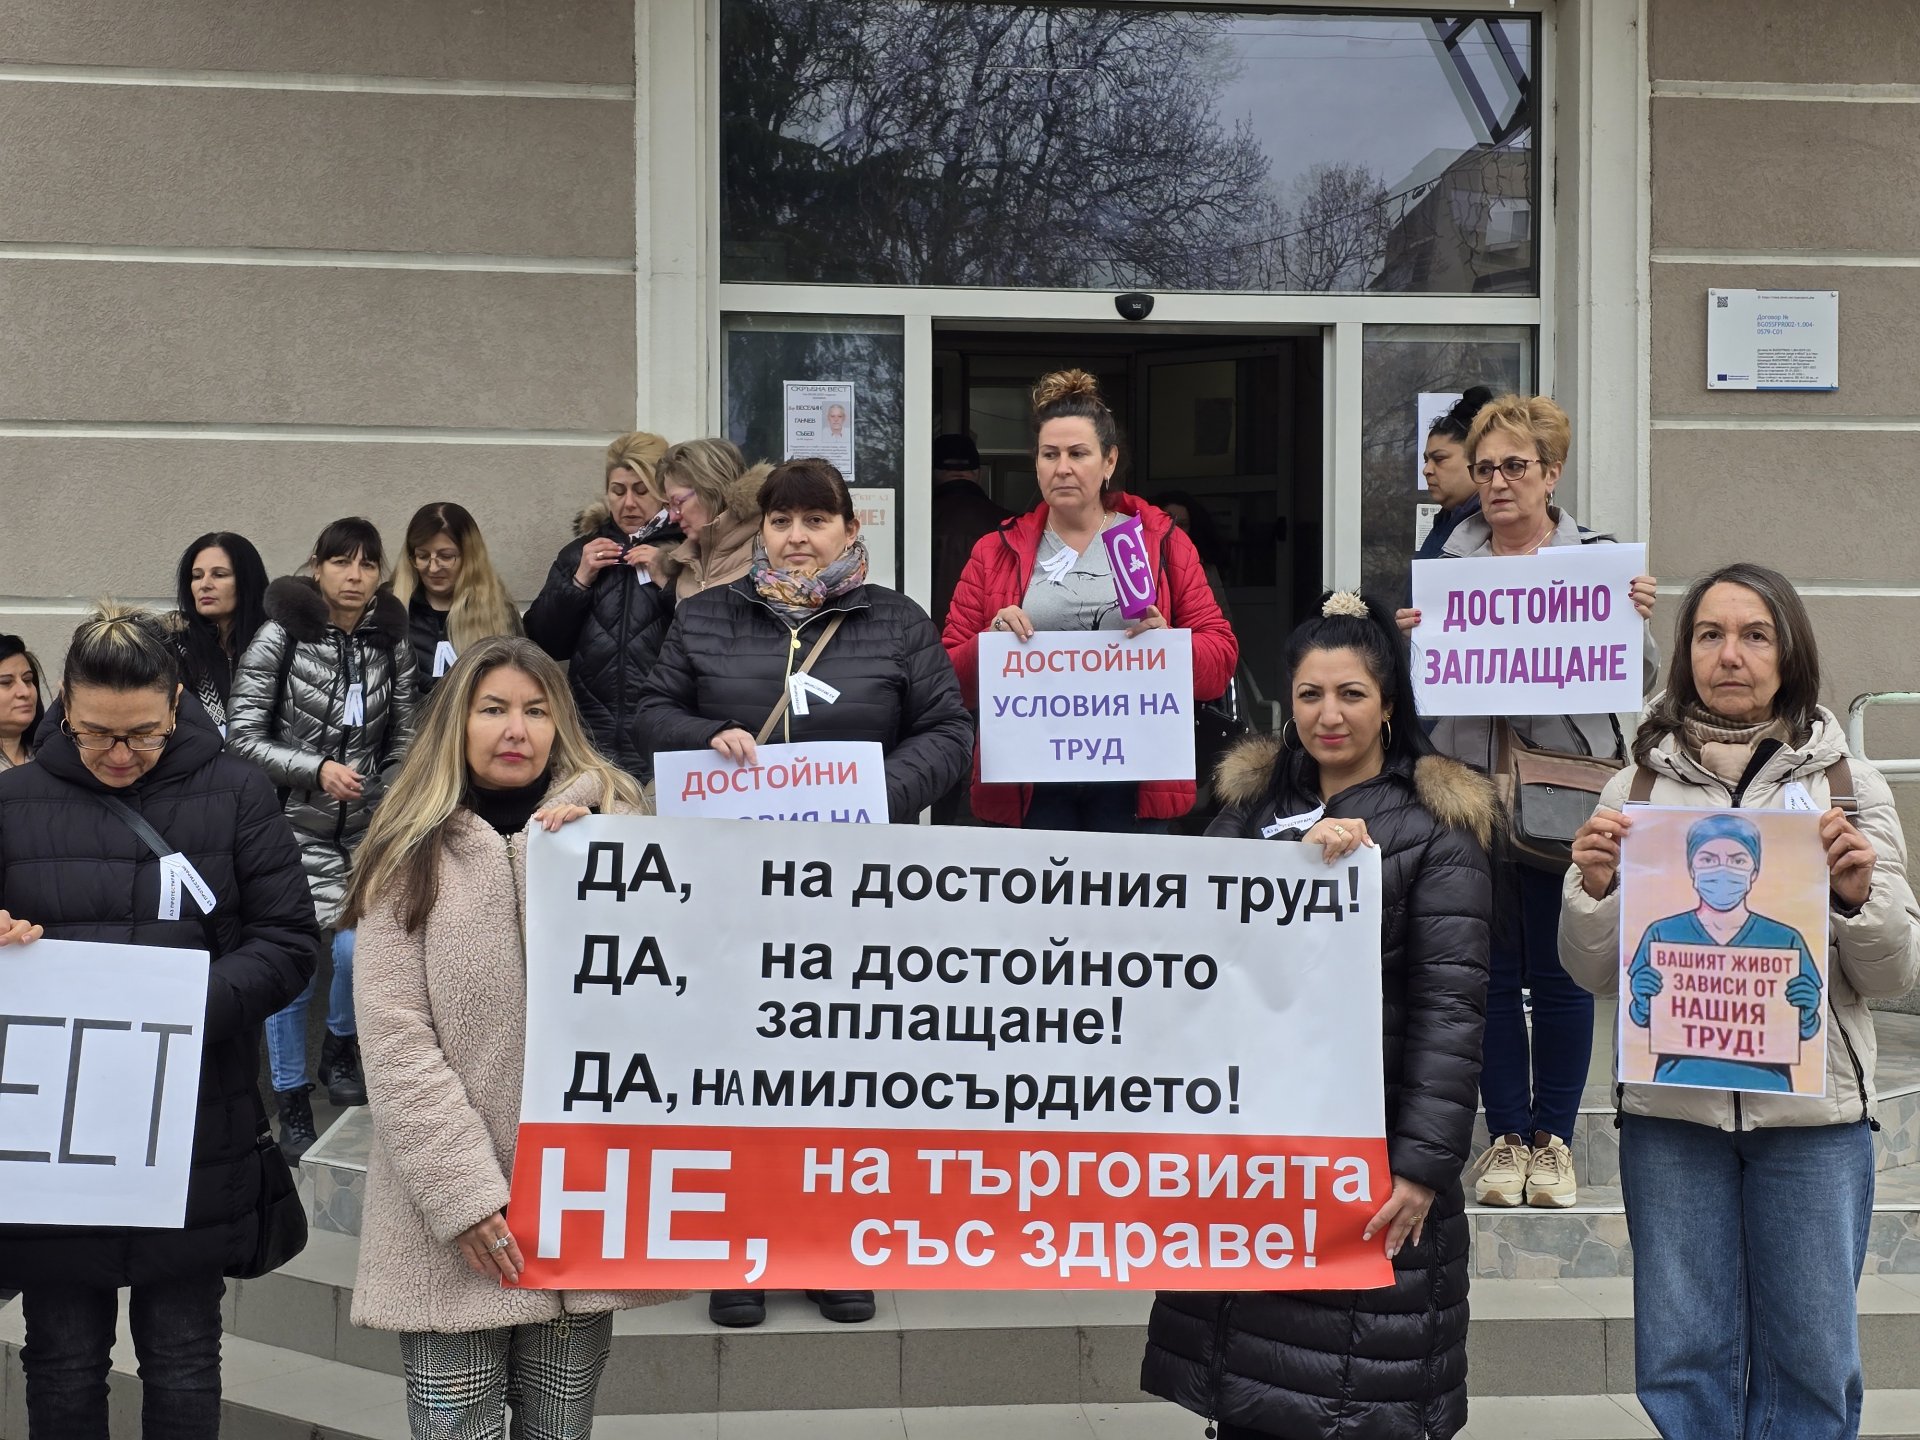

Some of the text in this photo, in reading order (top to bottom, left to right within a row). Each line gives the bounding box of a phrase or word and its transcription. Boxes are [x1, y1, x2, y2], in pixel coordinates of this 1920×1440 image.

[1443, 579, 1611, 632] ДОСТОЙНО
[1002, 643, 1166, 678] ДОСТОЙНИ
[1424, 644, 1627, 689] ЗАПЛАЩАНЕ
[993, 692, 1180, 717] УСЛОВИЯ НА
[1049, 737, 1125, 765] ТРУД
[681, 756, 858, 801] ДОСТОЙНИ
[577, 841, 1360, 926] ДА, на достойния труд!
[573, 934, 1218, 996] ДА, на достойното
[1656, 950, 1793, 974] ВАШИЯТ ЖИВОТ
[1673, 973, 1777, 998] ЗАВИСИ ОТ
[756, 996, 1123, 1051] заплащане!
[1671, 996, 1765, 1025] НАШИЯ
[1682, 1024, 1764, 1057] ТРУД!
[562, 1051, 678, 1113] ДА,
[752, 1065, 1240, 1123] милосърдието!
[537, 1147, 1372, 1284] НЕ, на търговията
[850, 1209, 1317, 1282] със здраве!
